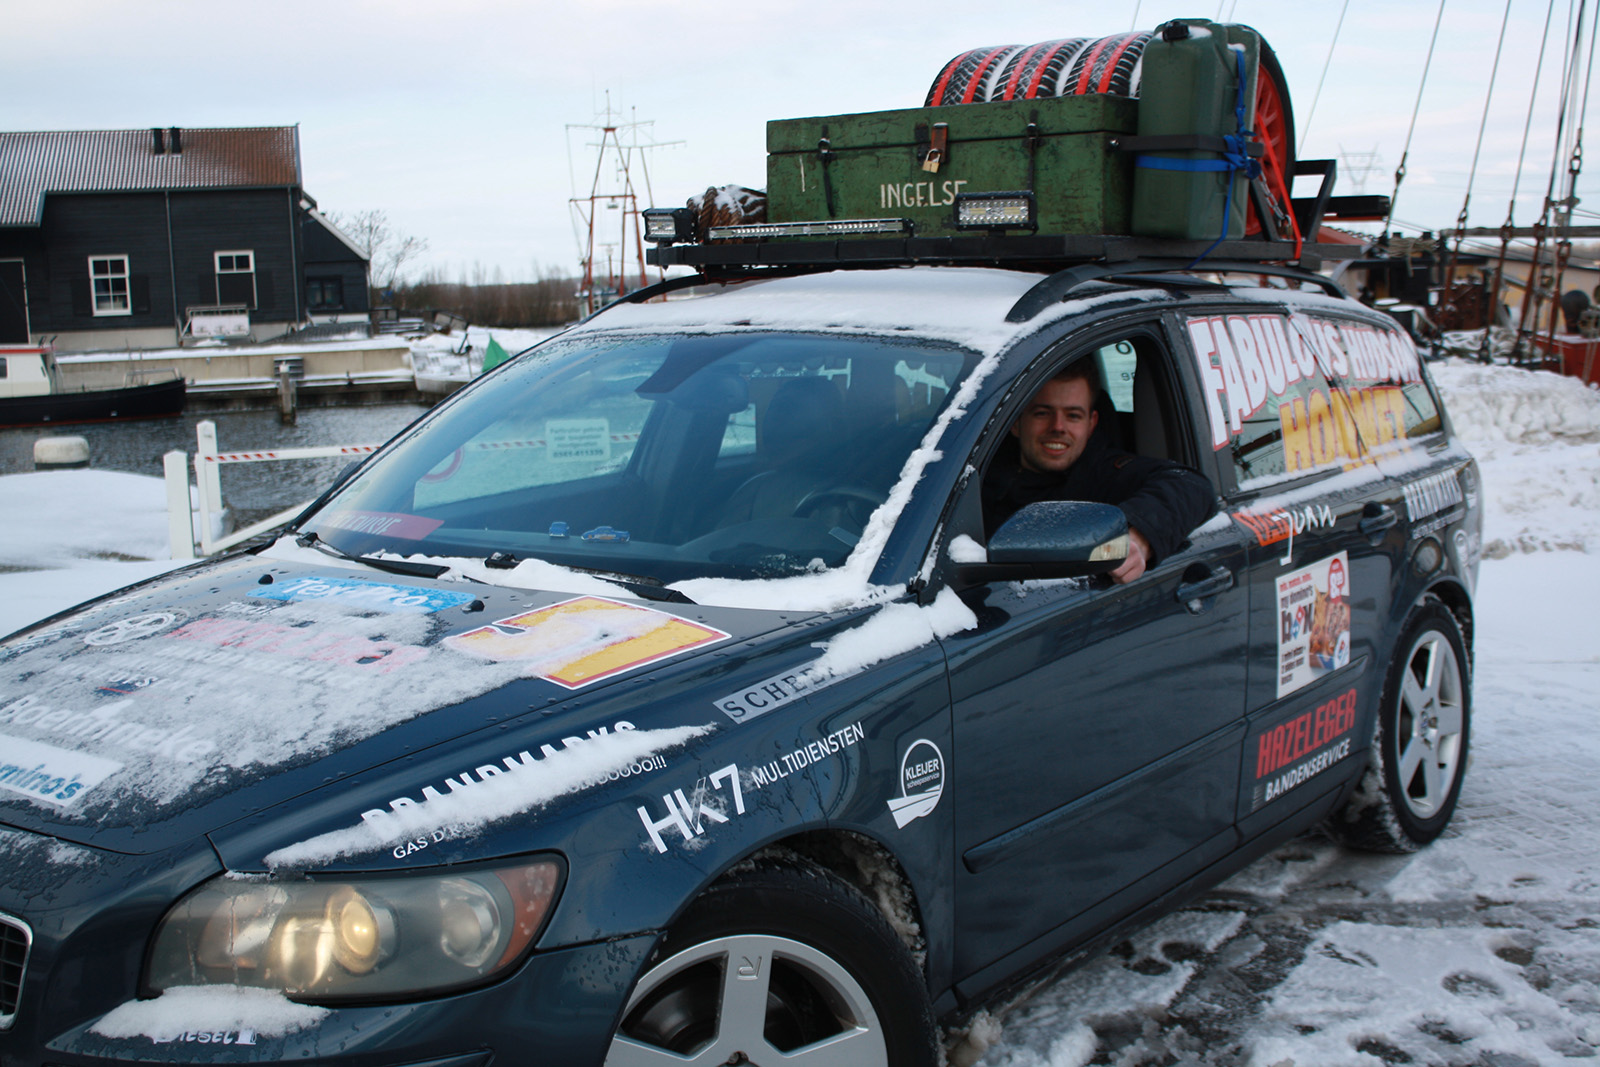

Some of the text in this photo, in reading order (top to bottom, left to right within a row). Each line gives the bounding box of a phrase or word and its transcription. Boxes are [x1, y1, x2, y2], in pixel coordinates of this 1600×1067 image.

[1187, 313, 1424, 451] FABULOUS HUDSON
[905, 758, 940, 781] KLEIJER
[1256, 687, 1358, 780] HAZELEGER
[1264, 738, 1352, 803] BANDENSERVICE
[636, 762, 746, 855] HK7
[751, 720, 866, 790] MULTIDIENSTEN
[392, 836, 429, 860] GAS
